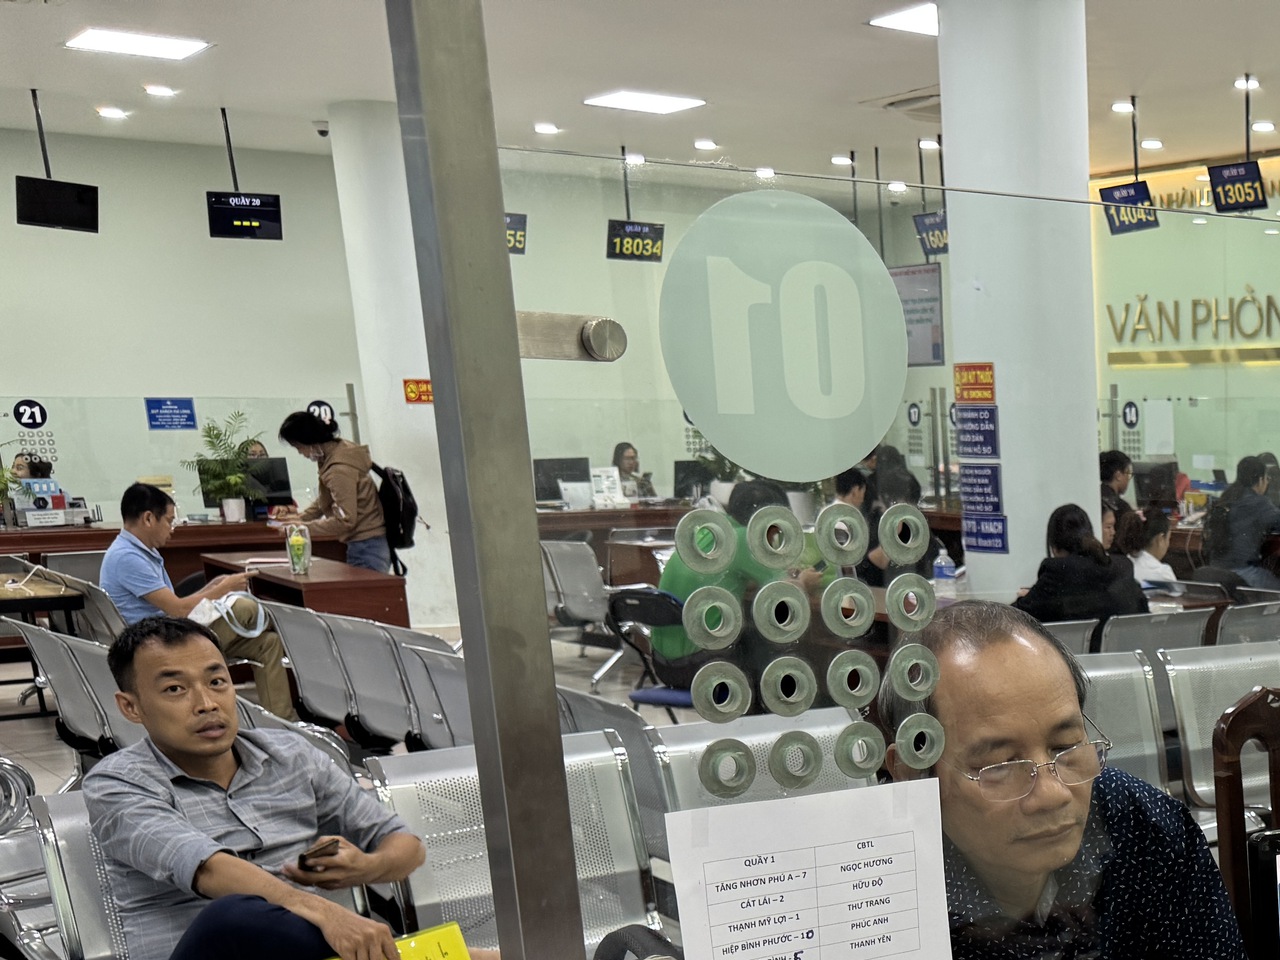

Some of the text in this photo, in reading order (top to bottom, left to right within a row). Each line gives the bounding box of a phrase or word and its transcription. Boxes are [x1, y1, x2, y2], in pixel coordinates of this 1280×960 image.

[229, 195, 251, 206] QUẦY
[1216, 181, 1264, 206] 13051
[1109, 200, 1156, 227] 14045
[613, 237, 662, 256] 18034
[1106, 294, 1180, 343] VĂN
[19, 404, 42, 425] 21
[1124, 406, 1137, 425] 14
[856, 840, 875, 850] CBTL
[743, 854, 776, 867] QUẦY 1
[840, 857, 893, 874] NGỌC HƯƠNG
[715, 881, 738, 893] TĂNG
[739, 878, 766, 889] NHƠN
[768, 874, 786, 885] PHÚ
[787, 872, 794, 881] A
[801, 871, 807, 879] 7
[852, 877, 883, 890] HỮU ĐỘ
[740, 899, 756, 909] CÁT
[758, 895, 771, 906] LÁI
[779, 895, 785, 903] 2
[847, 897, 891, 911] THƯ TRANG
[728, 920, 757, 933] THẠNH
[758, 917, 772, 927] MỸ
[773, 914, 787, 926] LỢI
[795, 913, 800, 921] 1
[851, 917, 889, 930] PHÚC ANH
[722, 944, 740, 956] HIỆP
[740, 939, 761, 951] BÌNH
[762, 933, 793, 947] PHƯỚC
[800, 929, 815, 941] 10
[850, 935, 892, 950] THANH YÊN
